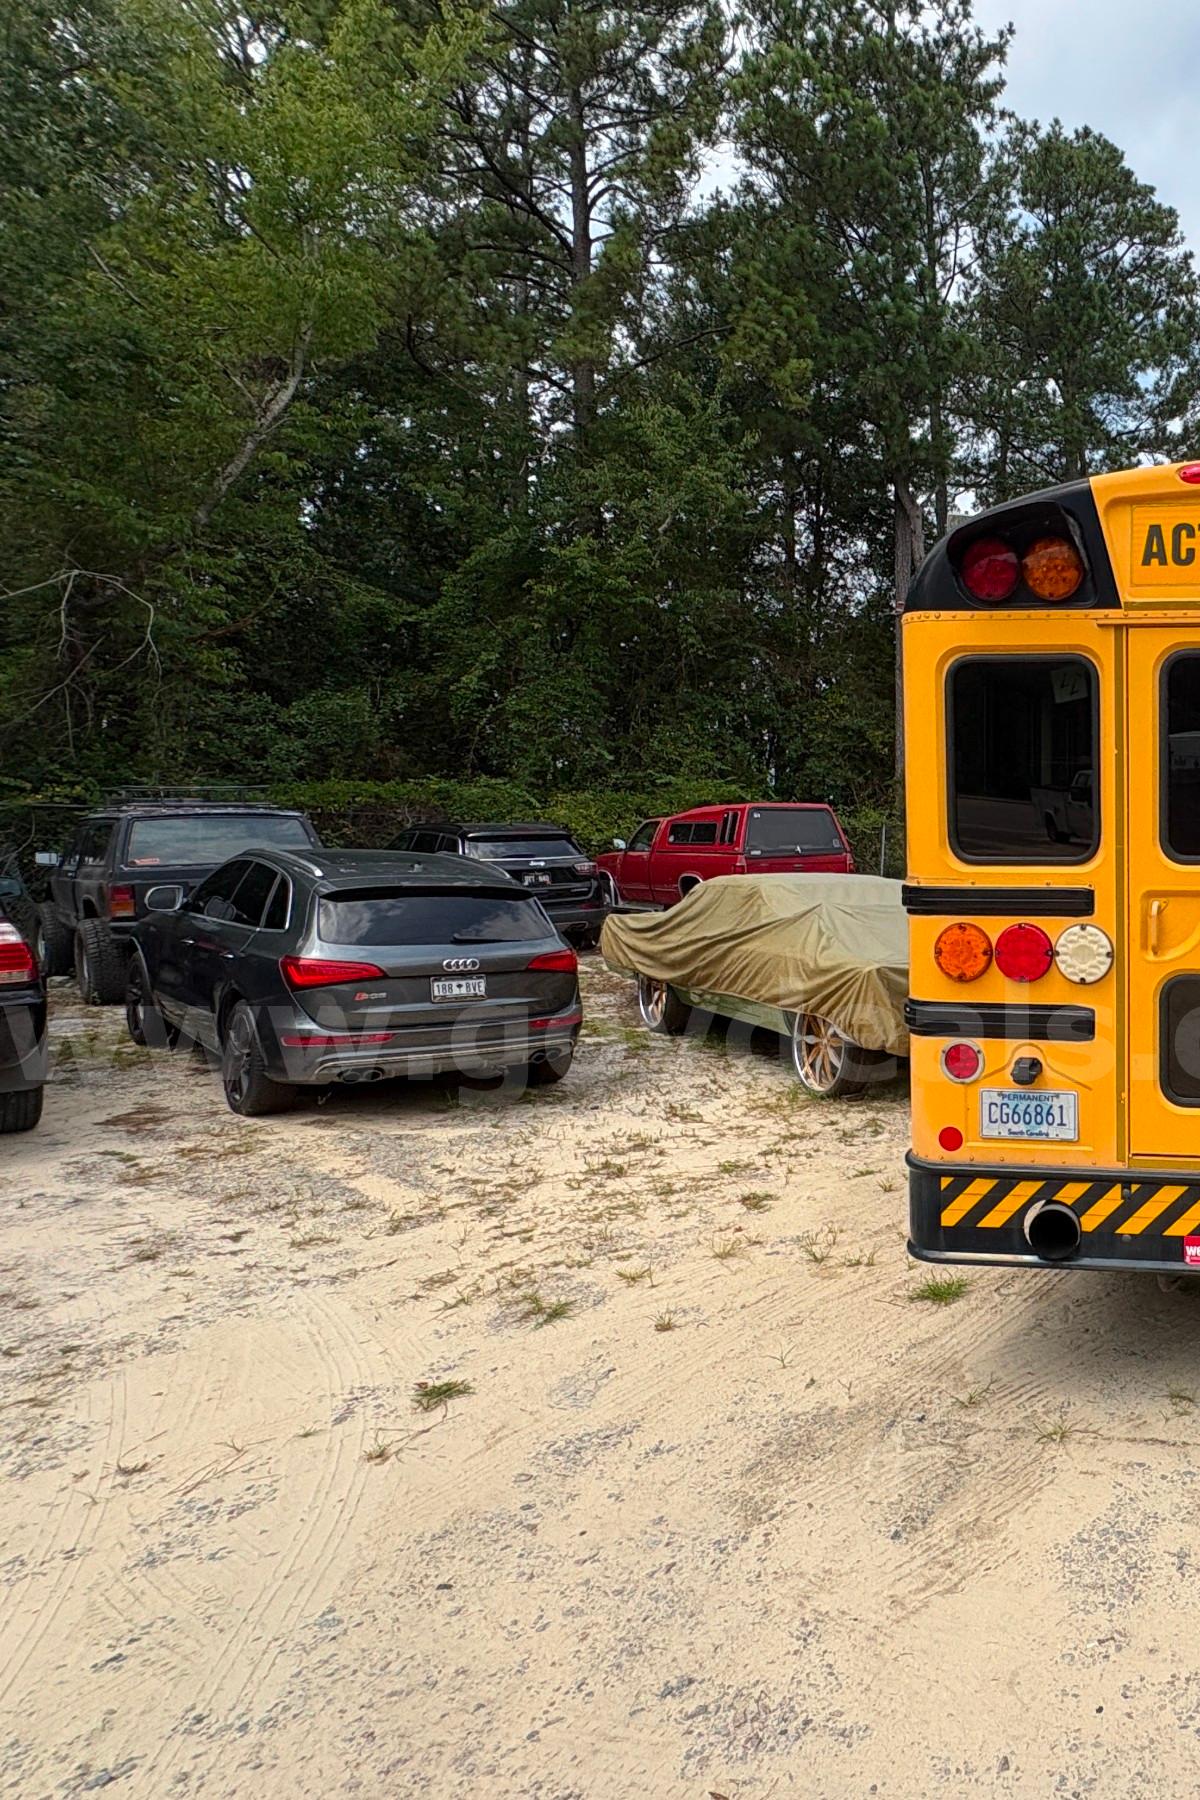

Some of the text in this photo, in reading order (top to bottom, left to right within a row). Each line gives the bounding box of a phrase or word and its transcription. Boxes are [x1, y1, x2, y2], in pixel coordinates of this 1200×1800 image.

[1001, 1092, 1055, 1103] PERMANENT
[988, 1102, 1067, 1127] CG66861
[1008, 1128, 1049, 1138] South Carolina
